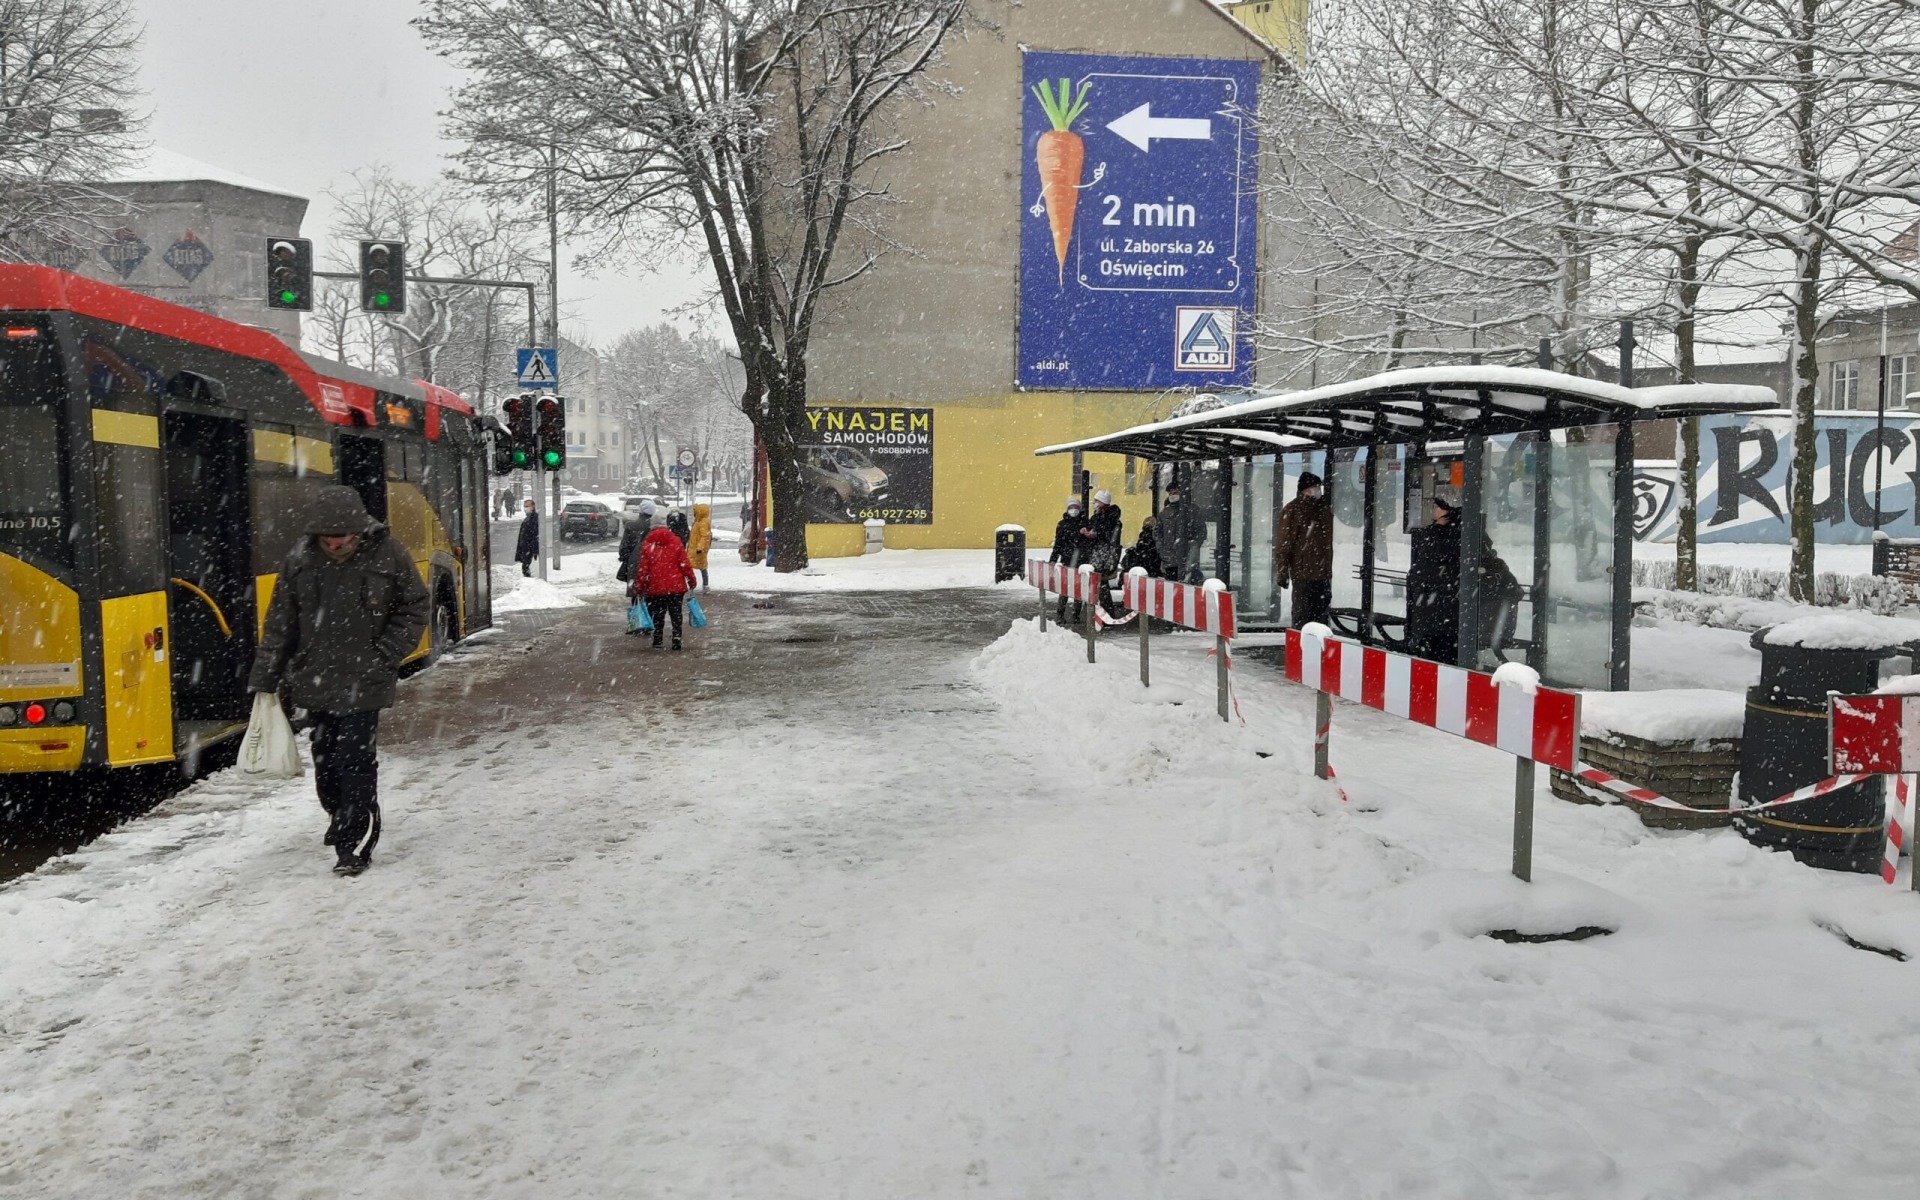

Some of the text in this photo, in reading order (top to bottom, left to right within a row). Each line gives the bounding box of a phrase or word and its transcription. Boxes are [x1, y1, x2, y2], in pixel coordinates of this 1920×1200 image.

[1102, 195, 1196, 227] 2 min
[1100, 240, 1215, 254] ul. Zaborska 26
[1100, 259, 1184, 280] Oświęcim
[1185, 352, 1225, 364] ALDI
[1036, 360, 1069, 372] aldi.pl
[805, 411, 928, 431] YNAJEM
[823, 431, 929, 444] SAMOCHODÓW
[859, 509, 927, 519] 661 927 295
[30, 516, 61, 531] 10,5
